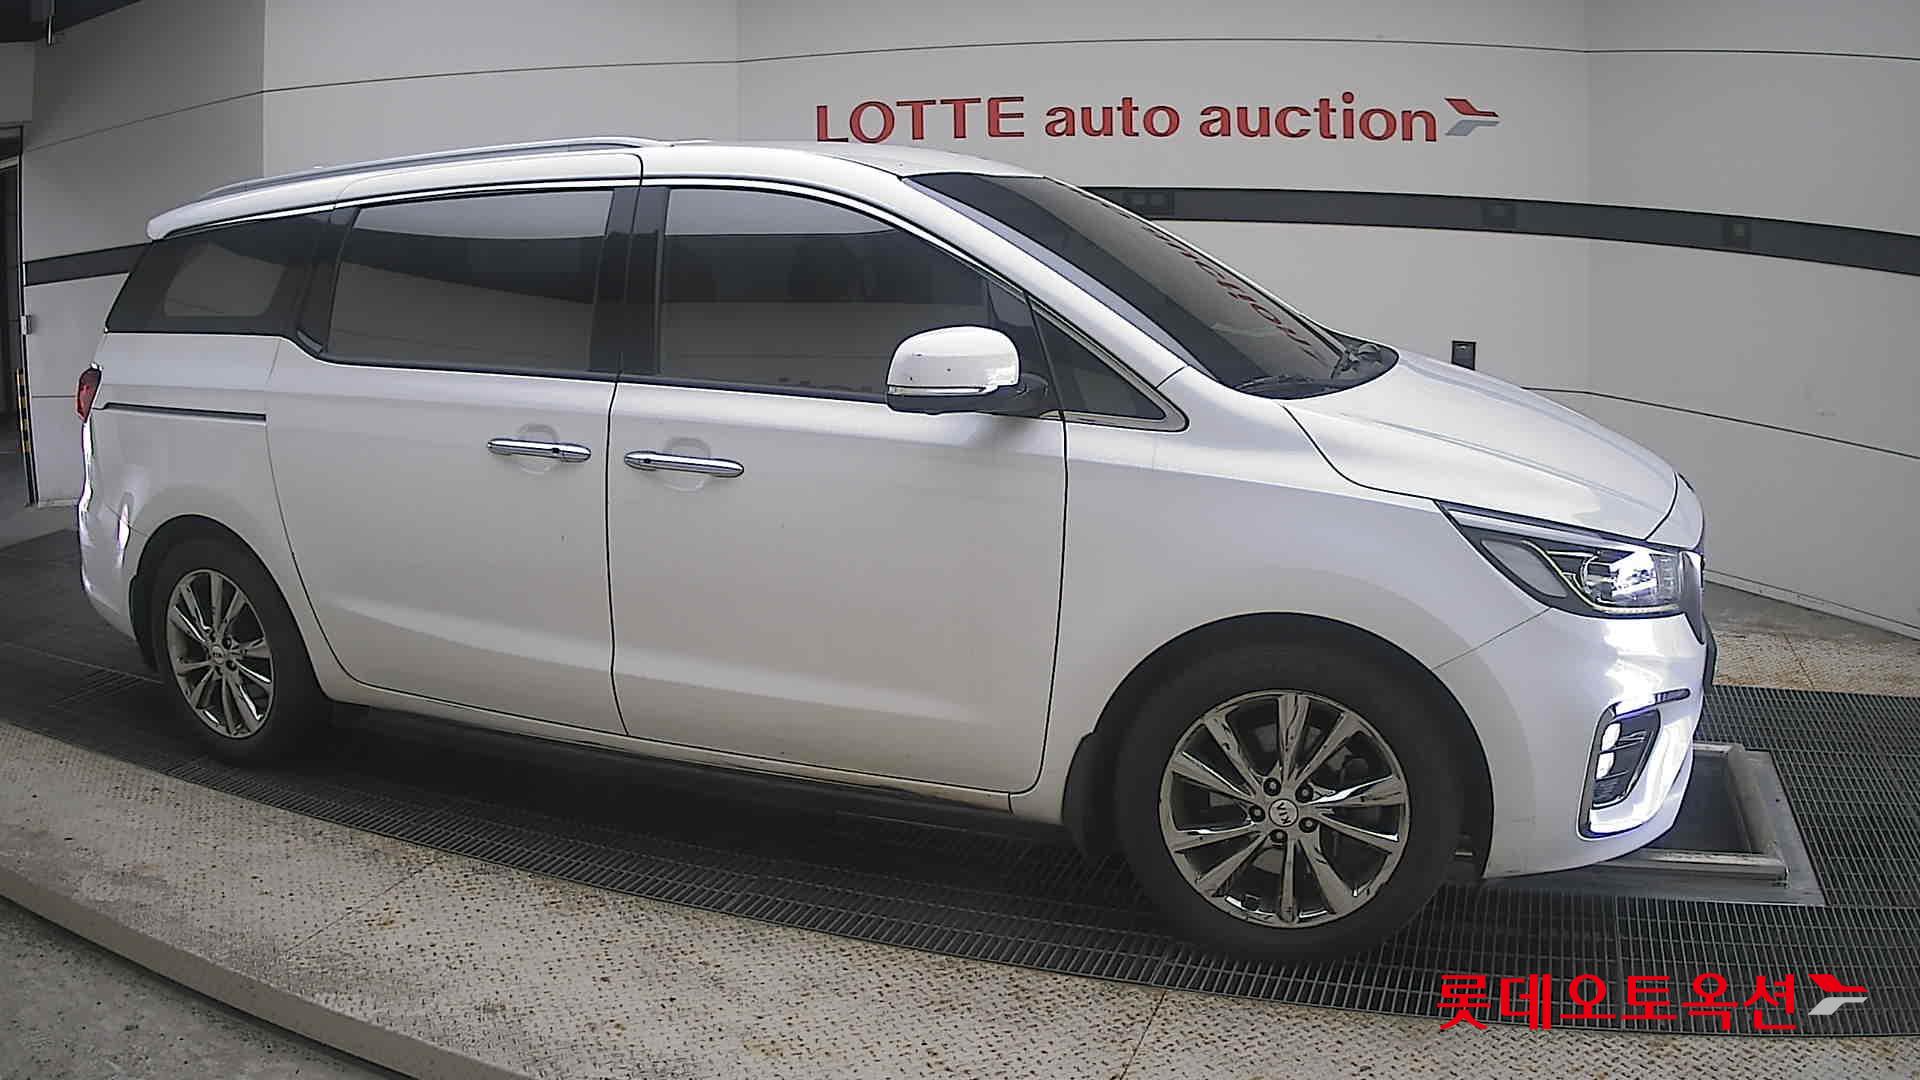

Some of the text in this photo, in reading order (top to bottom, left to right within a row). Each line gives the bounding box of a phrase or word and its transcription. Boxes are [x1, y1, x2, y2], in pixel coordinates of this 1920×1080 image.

[816, 92, 1438, 142] LOTTE auto auction
